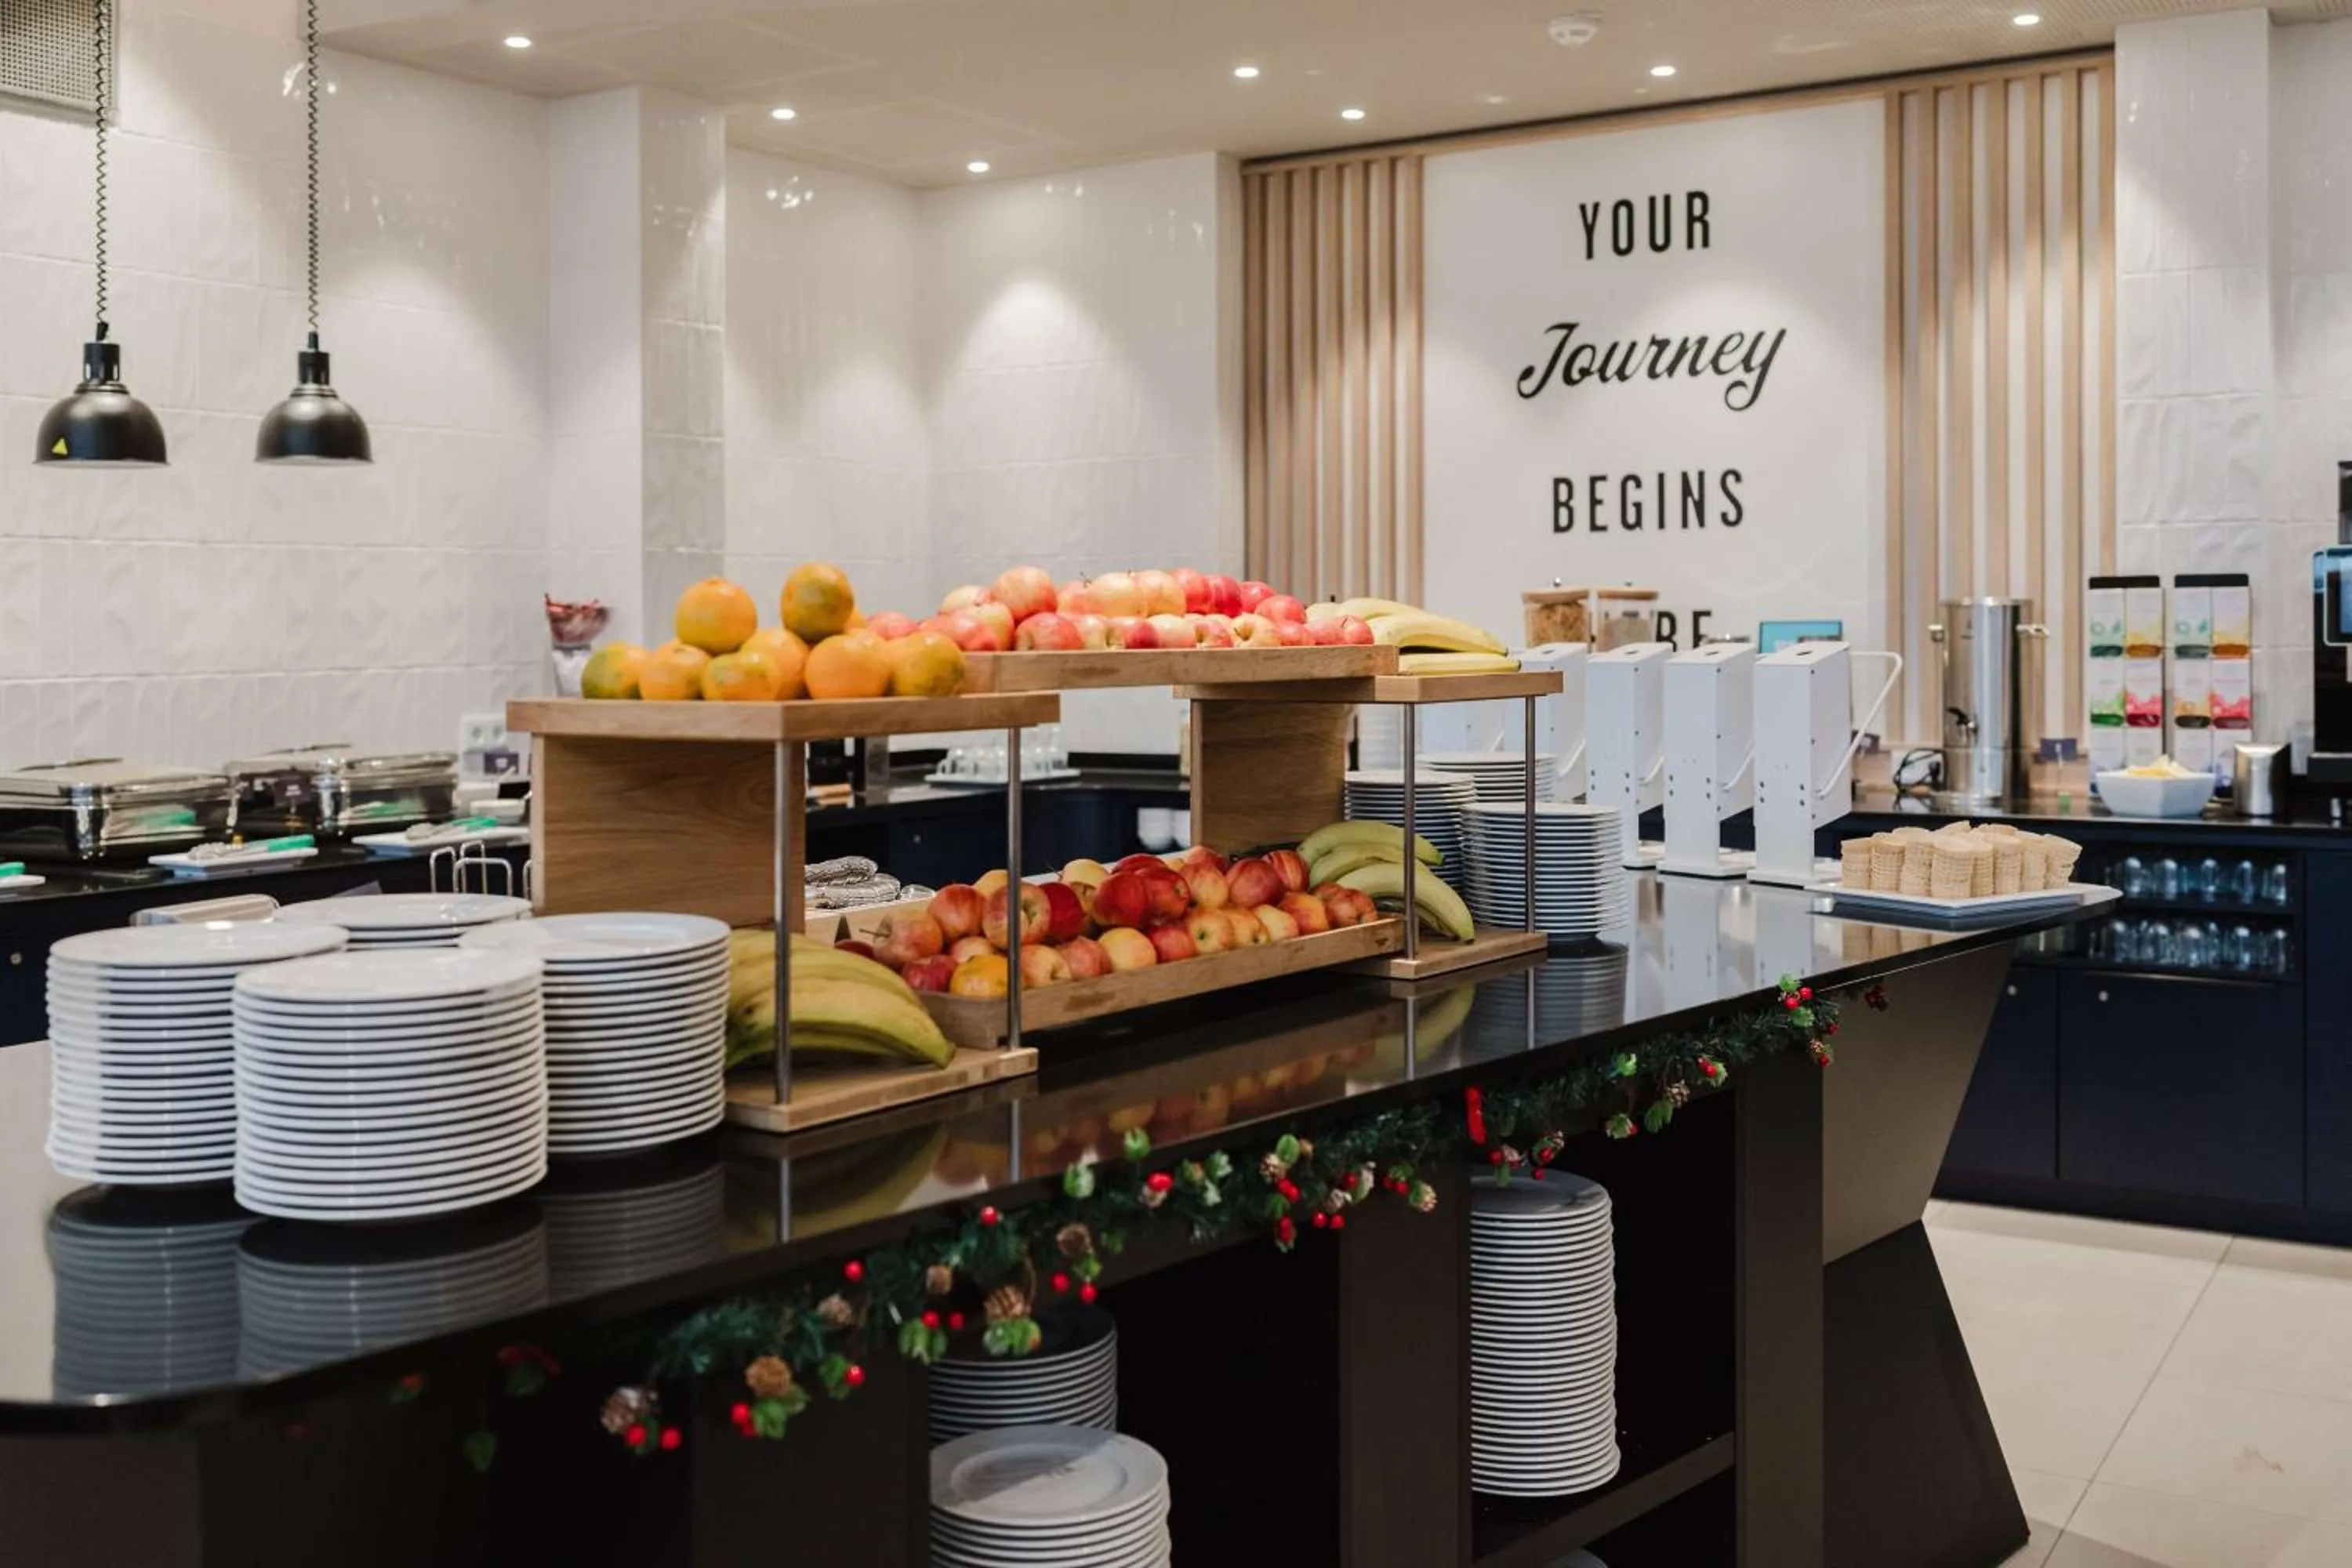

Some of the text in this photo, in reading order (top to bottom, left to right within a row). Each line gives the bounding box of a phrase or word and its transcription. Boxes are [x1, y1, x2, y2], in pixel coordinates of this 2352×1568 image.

[1578, 191, 1710, 260] YOUR
[1516, 321, 1787, 411] Journey
[1552, 469, 1744, 533] BEGINS
